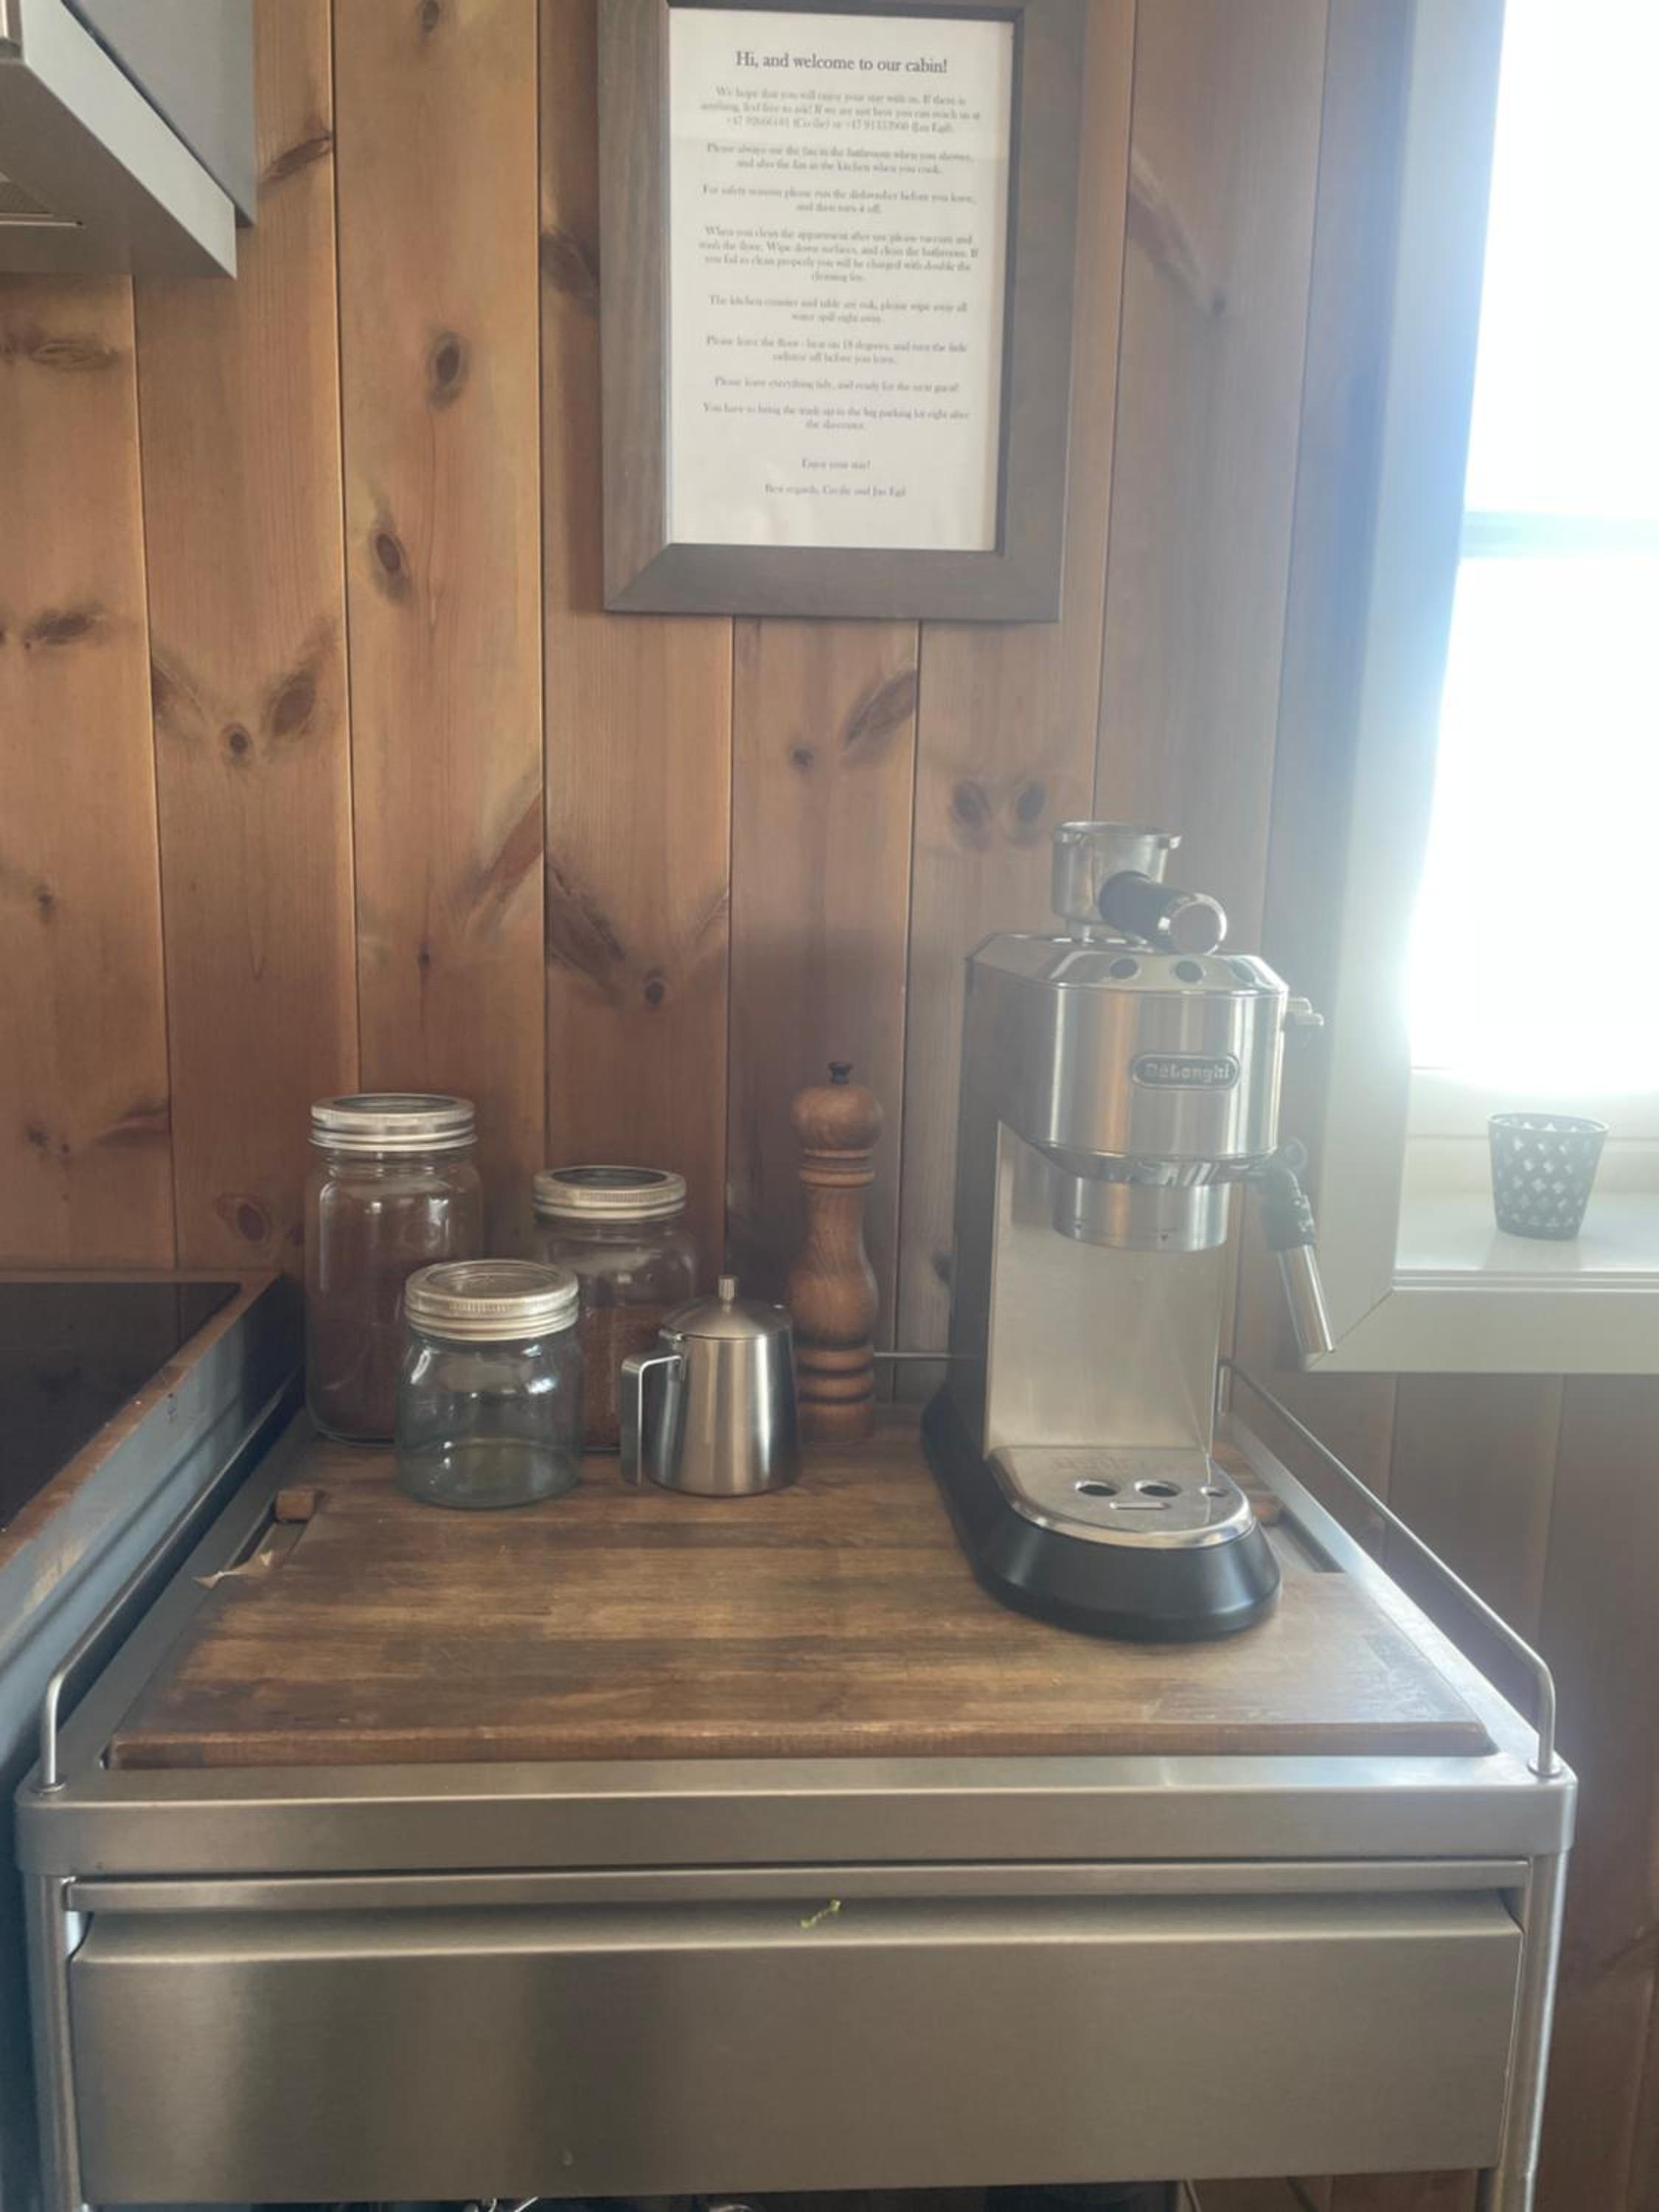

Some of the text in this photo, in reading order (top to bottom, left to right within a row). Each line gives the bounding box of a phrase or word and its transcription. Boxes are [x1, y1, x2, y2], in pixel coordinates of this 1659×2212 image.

[737, 50, 947, 74] Hi, and welcome to our cabin!
